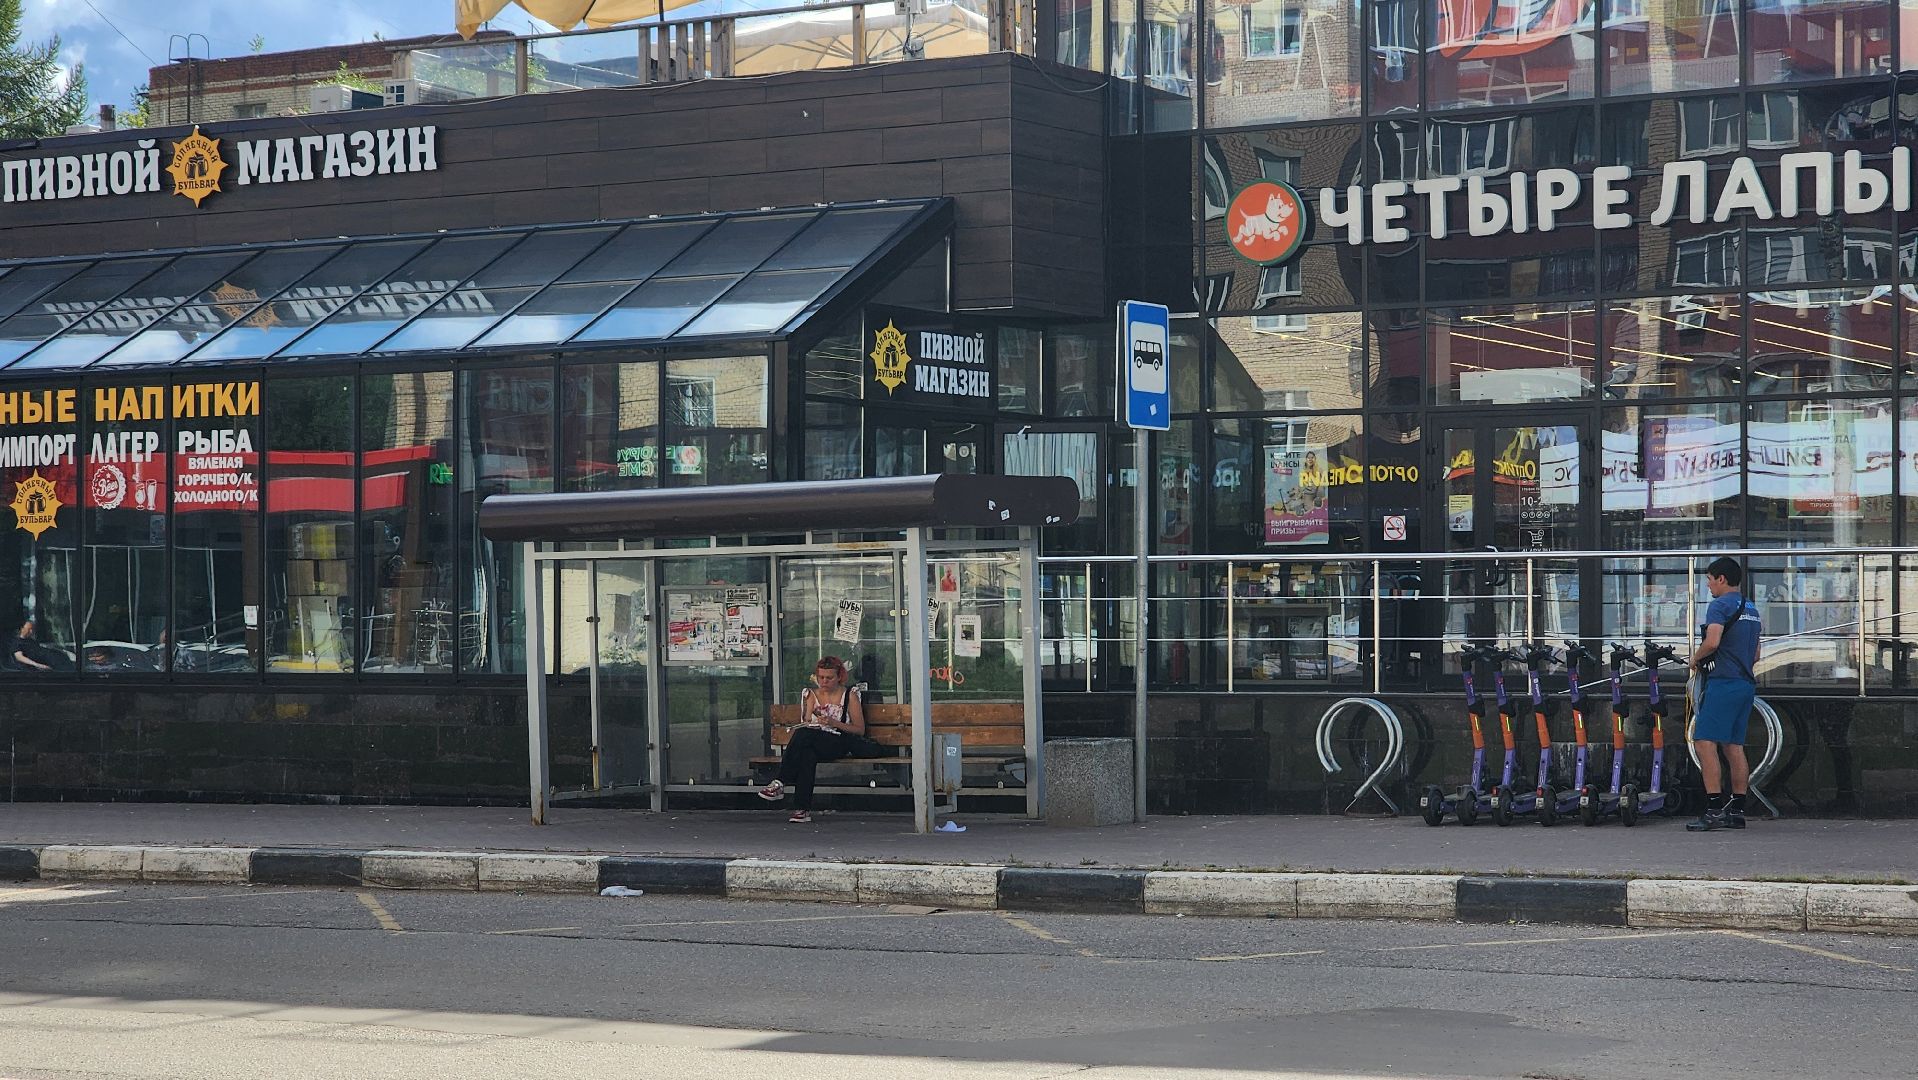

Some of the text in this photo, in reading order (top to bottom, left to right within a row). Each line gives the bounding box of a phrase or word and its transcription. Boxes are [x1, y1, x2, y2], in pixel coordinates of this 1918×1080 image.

[2, 126, 437, 203] ПИВНОЙ МАГАЗИН
[173, 139, 219, 169] СОЛНЕЧНЫЙ
[178, 178, 216, 191] БУЛЬВАР
[1319, 146, 1910, 246] ЧЕТЫРЕ ЛАПЫ
[875, 331, 905, 356] СОЛНЕЧНЫЙ
[920, 332, 985, 364] ПИВНОЙ
[878, 368, 904, 379] БУЛЬВАР
[914, 365, 990, 398] МАГАЗИН
[0, 381, 260, 425] НЫЕ НАПИТКИ
[0, 431, 159, 468] ИМПОРТ ЛАГЕР
[178, 428, 253, 455] РЫБА
[188, 456, 244, 470] ВЯЛЕНАЯ
[16, 479, 56, 504] СОЛНЕЧНЫЙ
[178, 472, 253, 487] ГОРЯЧЕГО/К
[174, 489, 259, 505] ХОЛОДНОГО/К
[20, 515, 53, 524] БУЛЬВАР
[1270, 527, 1296, 535] ПРИЗЫ
[840, 598, 862, 612] ШУБЫ
